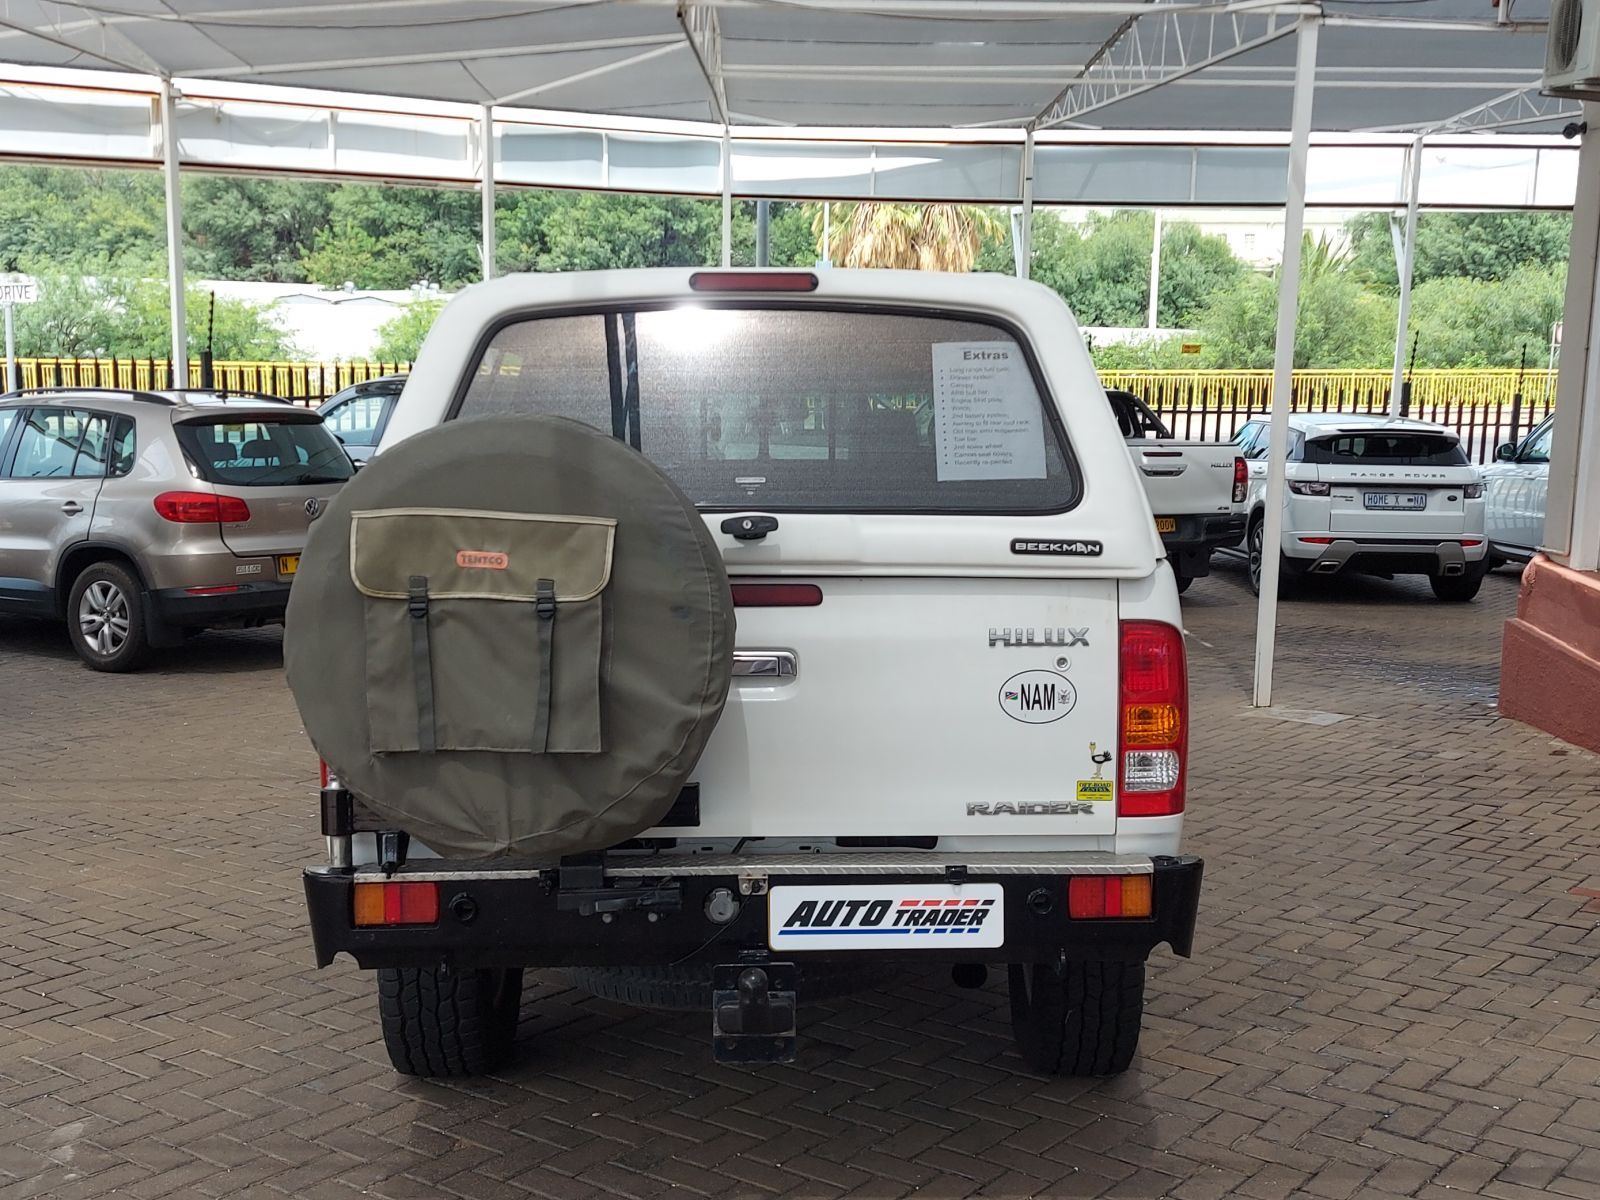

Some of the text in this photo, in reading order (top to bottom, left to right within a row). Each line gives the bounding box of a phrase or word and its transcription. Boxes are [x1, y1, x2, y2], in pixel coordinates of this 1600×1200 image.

[963, 351, 1009, 360] Extras
[1367, 494, 1389, 505] HOME
[1015, 542, 1100, 554] BEEKMAN
[281, 558, 288, 572] N
[461, 554, 503, 565] TENTCO
[988, 627, 1090, 647] HILUX
[1020, 683, 1055, 711] NAM
[966, 801, 1095, 816] RAIDER
[783, 900, 990, 928] AUTO TRADER
